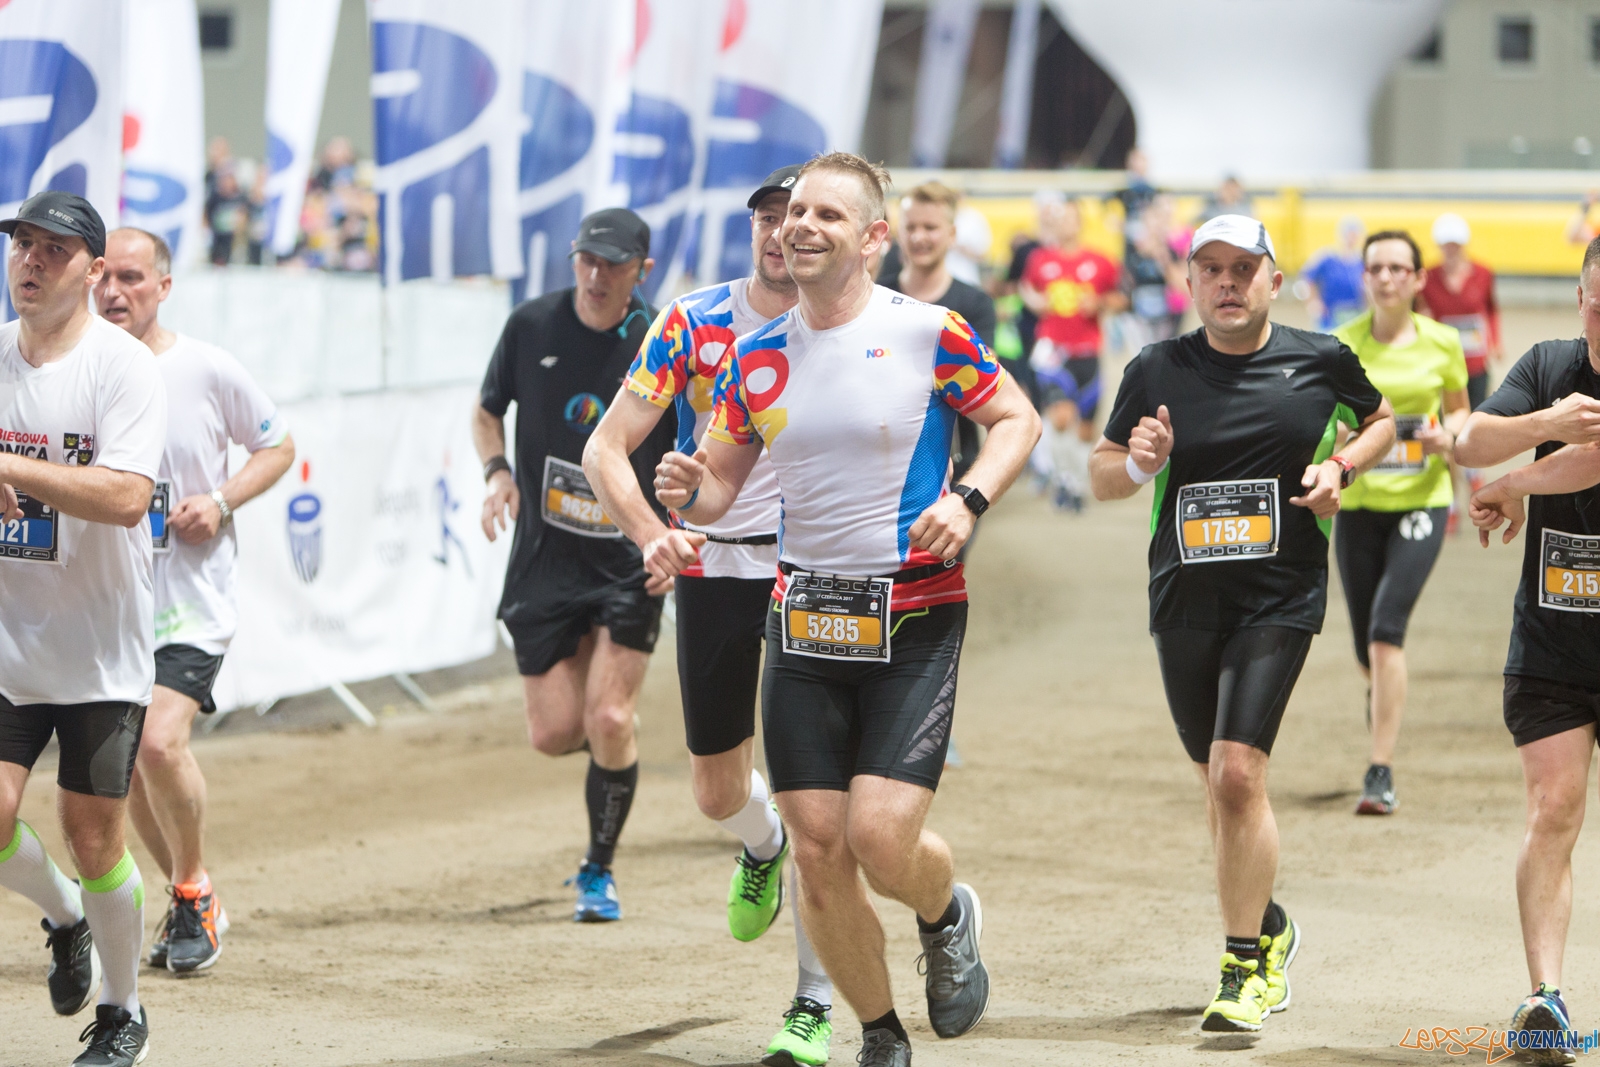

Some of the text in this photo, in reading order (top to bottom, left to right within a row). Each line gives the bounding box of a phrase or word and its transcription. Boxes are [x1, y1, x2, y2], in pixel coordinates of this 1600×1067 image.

[1202, 518, 1251, 544] 1752
[1562, 571, 1600, 595] 215
[807, 614, 860, 642] 5285
